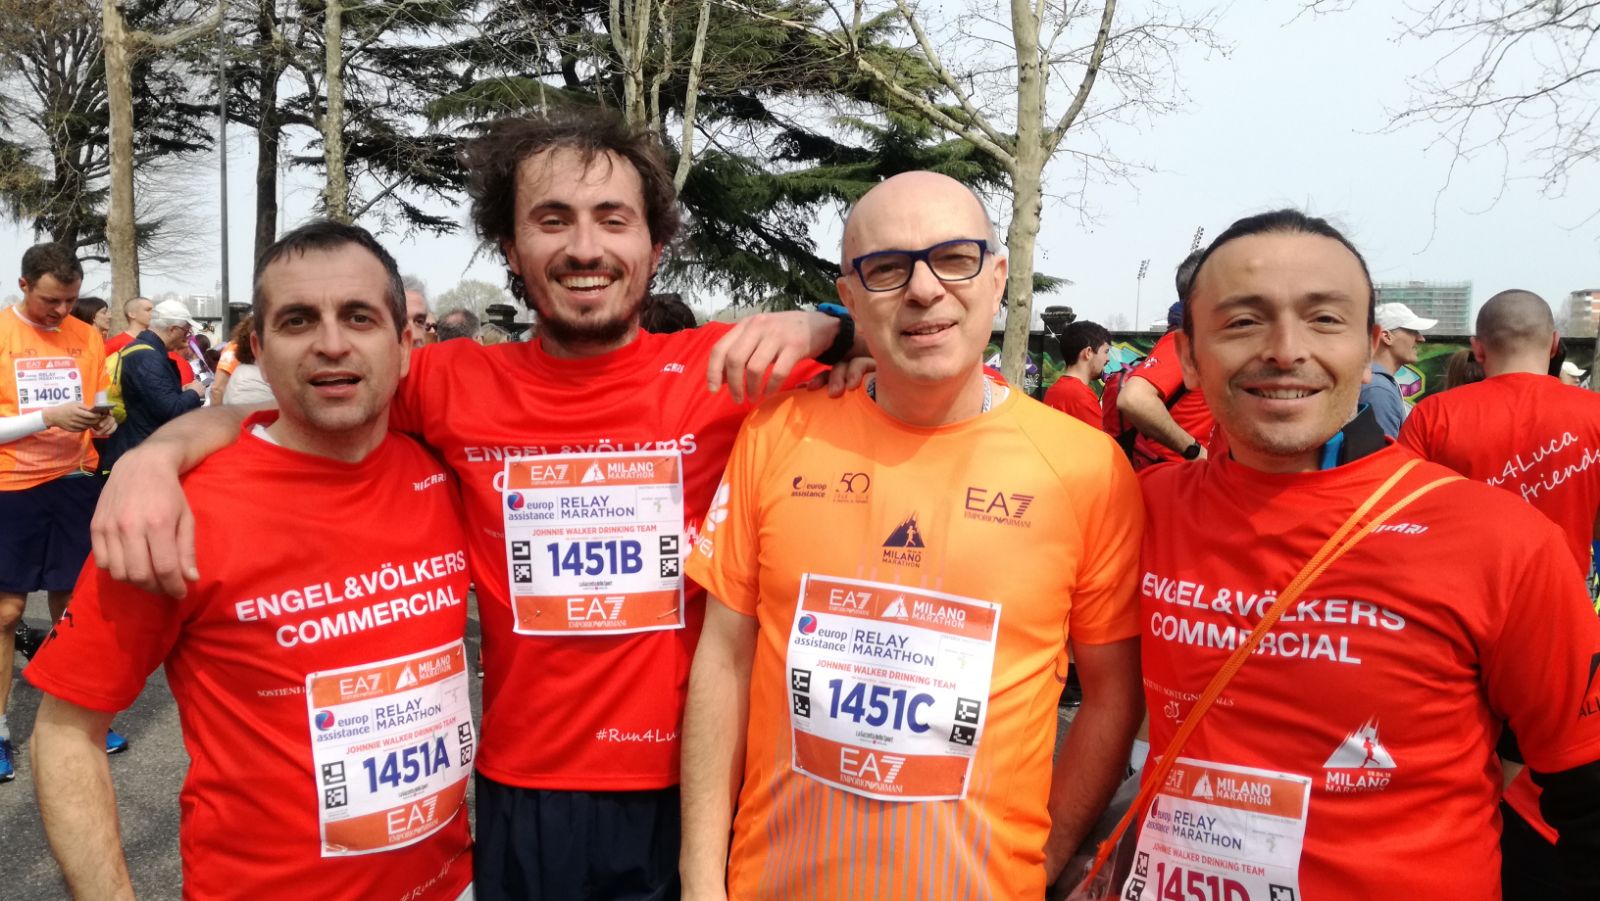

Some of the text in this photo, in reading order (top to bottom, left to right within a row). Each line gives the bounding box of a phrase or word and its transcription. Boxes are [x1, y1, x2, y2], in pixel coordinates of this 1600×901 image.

[34, 388, 70, 401] 1410C
[531, 464, 569, 481] EA7
[608, 462, 654, 474] MILANO
[608, 472, 654, 480] MARATHON
[806, 484, 826, 492] europ
[840, 472, 870, 494] 50
[561, 496, 610, 508] RELAY
[791, 490, 826, 498] assistance
[965, 486, 1034, 518] EA7
[508, 510, 554, 521] assistance
[527, 500, 554, 512] europ
[561, 506, 634, 519] MARATHON
[964, 511, 1032, 528] EMPORIO ARMANI
[532, 525, 657, 536] JOHNNIE WALKER DRINKING TEAM
[547, 540, 643, 576] 1451B
[882, 550, 922, 562] MILANO
[882, 558, 920, 568] MARATHON
[235, 550, 466, 622] ENGEL&VÖLKERS
[567, 596, 626, 620] EA7
[829, 588, 872, 610] EA7
[276, 585, 460, 648] COMMERCIAL
[913, 600, 966, 622] MILANO
[912, 612, 965, 630] MARATHON
[794, 636, 846, 652] assistance
[818, 628, 848, 642] europ
[854, 630, 910, 649] RELAY
[418, 654, 450, 670] MILANO
[852, 644, 935, 666] MARATHON
[340, 673, 382, 696] EA7
[816, 660, 852, 672] JOHNNIE
[854, 665, 888, 678] WALKER
[889, 670, 930, 686] DRINKING
[933, 678, 956, 690] TEAM
[376, 697, 422, 718] RELAY
[828, 678, 935, 734] 1451C
[338, 714, 368, 728] europ
[376, 704, 442, 730] MARATHON
[316, 725, 370, 742] assistance
[346, 717, 456, 755] JOHNNIE WALKER DRINKING TEAM
[363, 736, 450, 793] 1451A
[840, 747, 906, 783] EA7
[840, 774, 903, 792] EMPORIO ARMANI
[1216, 777, 1271, 796] MILANO
[1326, 771, 1390, 788] MILANO
[1216, 791, 1271, 806] MARATHON
[387, 795, 438, 834] EA7
[1174, 810, 1216, 831] RELAY
[1172, 826, 1242, 850] MARATHON
[1173, 850, 1200, 863] WALKER
[1200, 855, 1239, 872] DRINKING
[1242, 864, 1265, 876] TEAM
[1157, 862, 1250, 901] 1451D
